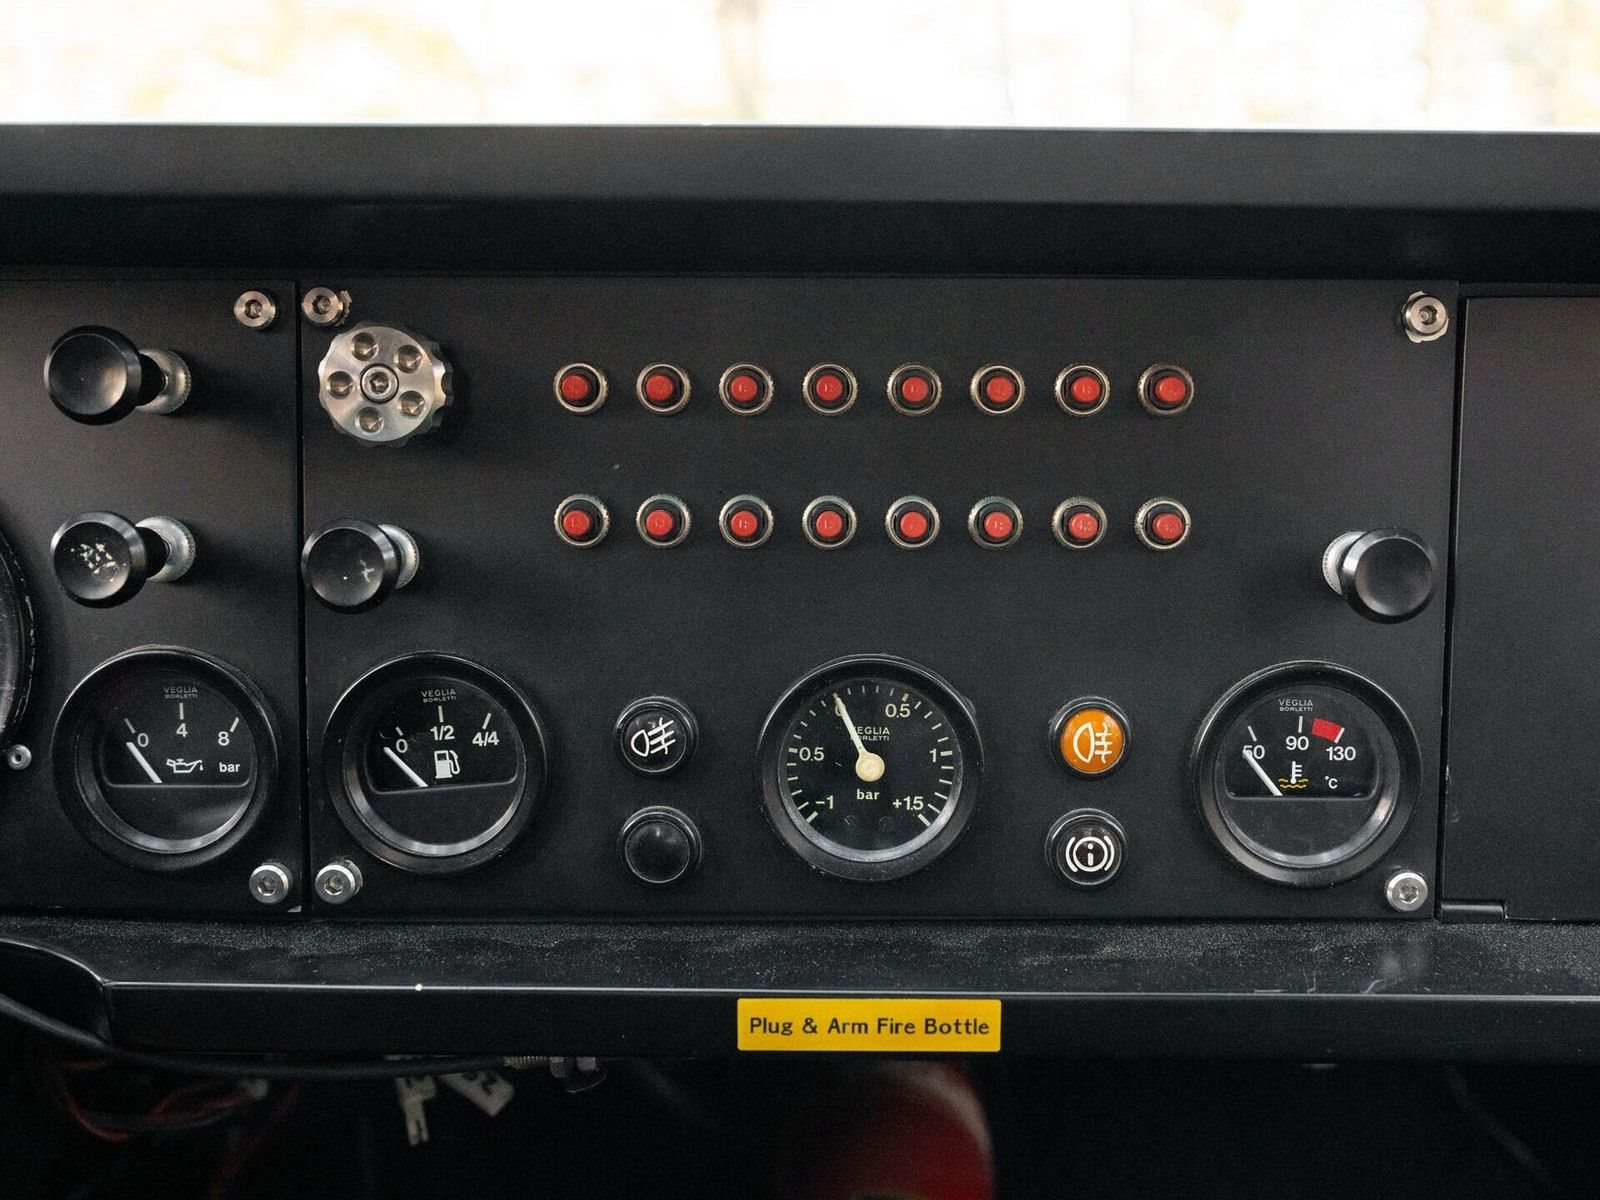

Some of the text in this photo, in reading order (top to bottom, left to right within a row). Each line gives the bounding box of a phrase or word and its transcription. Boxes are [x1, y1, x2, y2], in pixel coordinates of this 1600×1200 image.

[163, 686, 199, 694] VEGLIA
[420, 688, 457, 698] VEGLIA
[885, 703, 911, 718] 0.5
[1278, 699, 1314, 707] VEGLIA
[176, 722, 188, 738] 4
[430, 725, 455, 741] 1/2
[853, 726, 890, 735] EGLIA
[137, 733, 149, 748] 0
[217, 731, 230, 746] 8
[396, 739, 408, 753] 0
[472, 731, 500, 747] 4/4
[1285, 736, 1310, 751] 90
[799, 747, 825, 761] 0.5
[929, 748, 938, 763] 1
[1242, 744, 1266, 760] 50
[1326, 746, 1357, 761] 130
[219, 762, 240, 773] bar
[856, 788, 880, 800] bar
[816, 795, 835, 809] -1
[749, 1017, 990, 1036] Plug & Arm Fire Bottle
